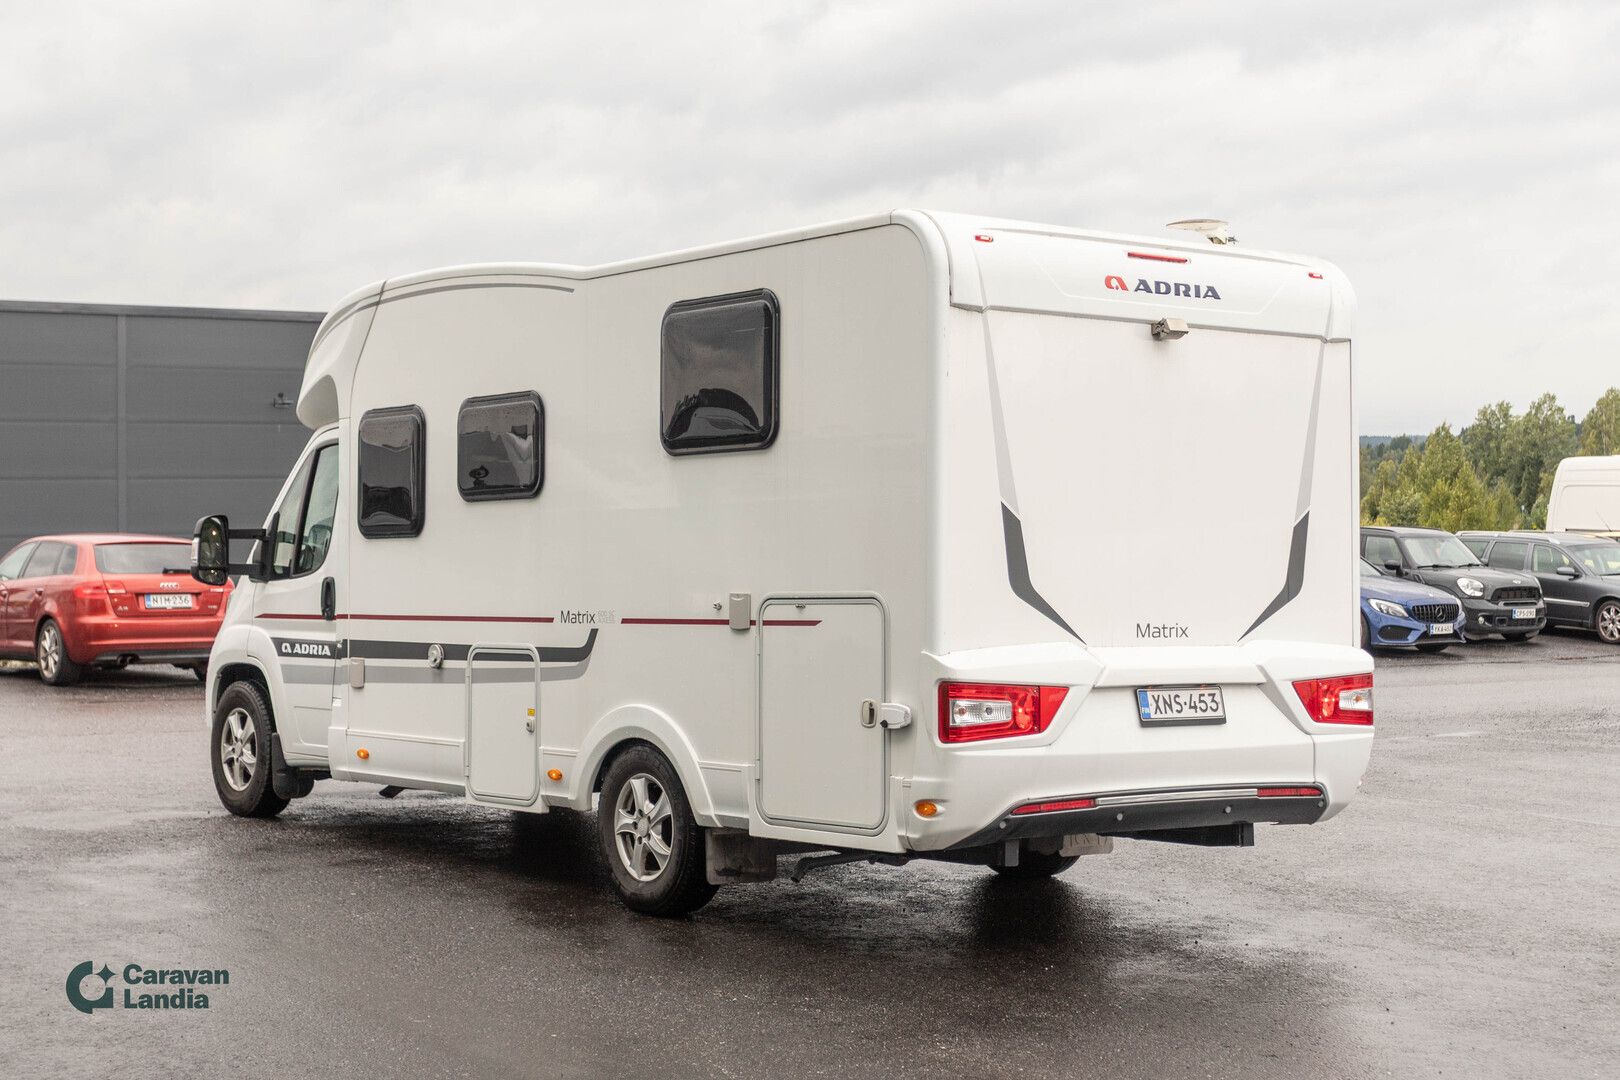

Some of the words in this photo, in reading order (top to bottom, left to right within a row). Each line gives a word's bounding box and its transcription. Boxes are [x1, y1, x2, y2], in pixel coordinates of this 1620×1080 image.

[1133, 278, 1222, 300] ADRIA
[560, 610, 596, 624] Matrix
[1136, 622, 1190, 639] Matrix
[293, 643, 331, 656] ADRIA
[1151, 692, 1220, 715] XNS-453
